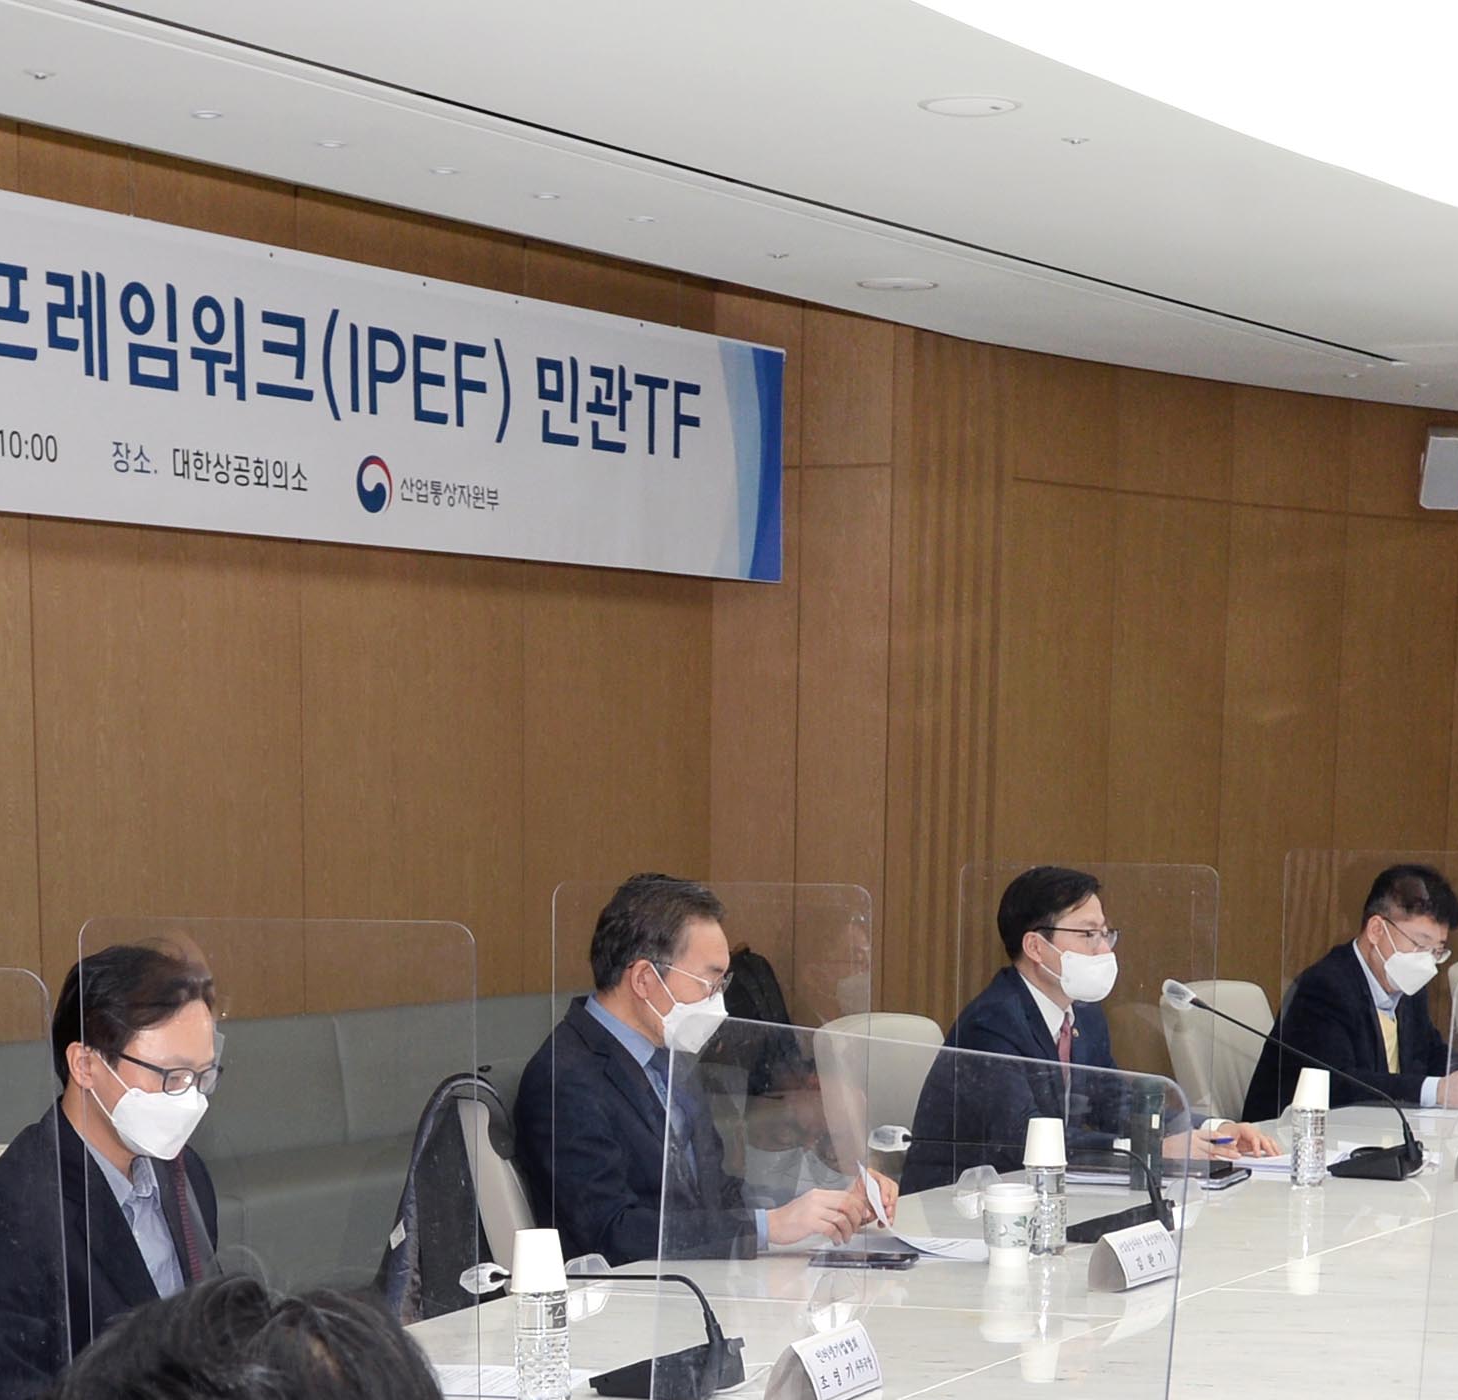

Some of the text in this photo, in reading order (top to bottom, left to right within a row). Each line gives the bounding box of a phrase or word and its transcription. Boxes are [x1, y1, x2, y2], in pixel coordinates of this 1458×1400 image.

[536, 355, 701, 460] 민관TF
[112, 441, 309, 492] 장소. 대한상공회의소
[400, 477, 500, 511] 산업통상자원부
